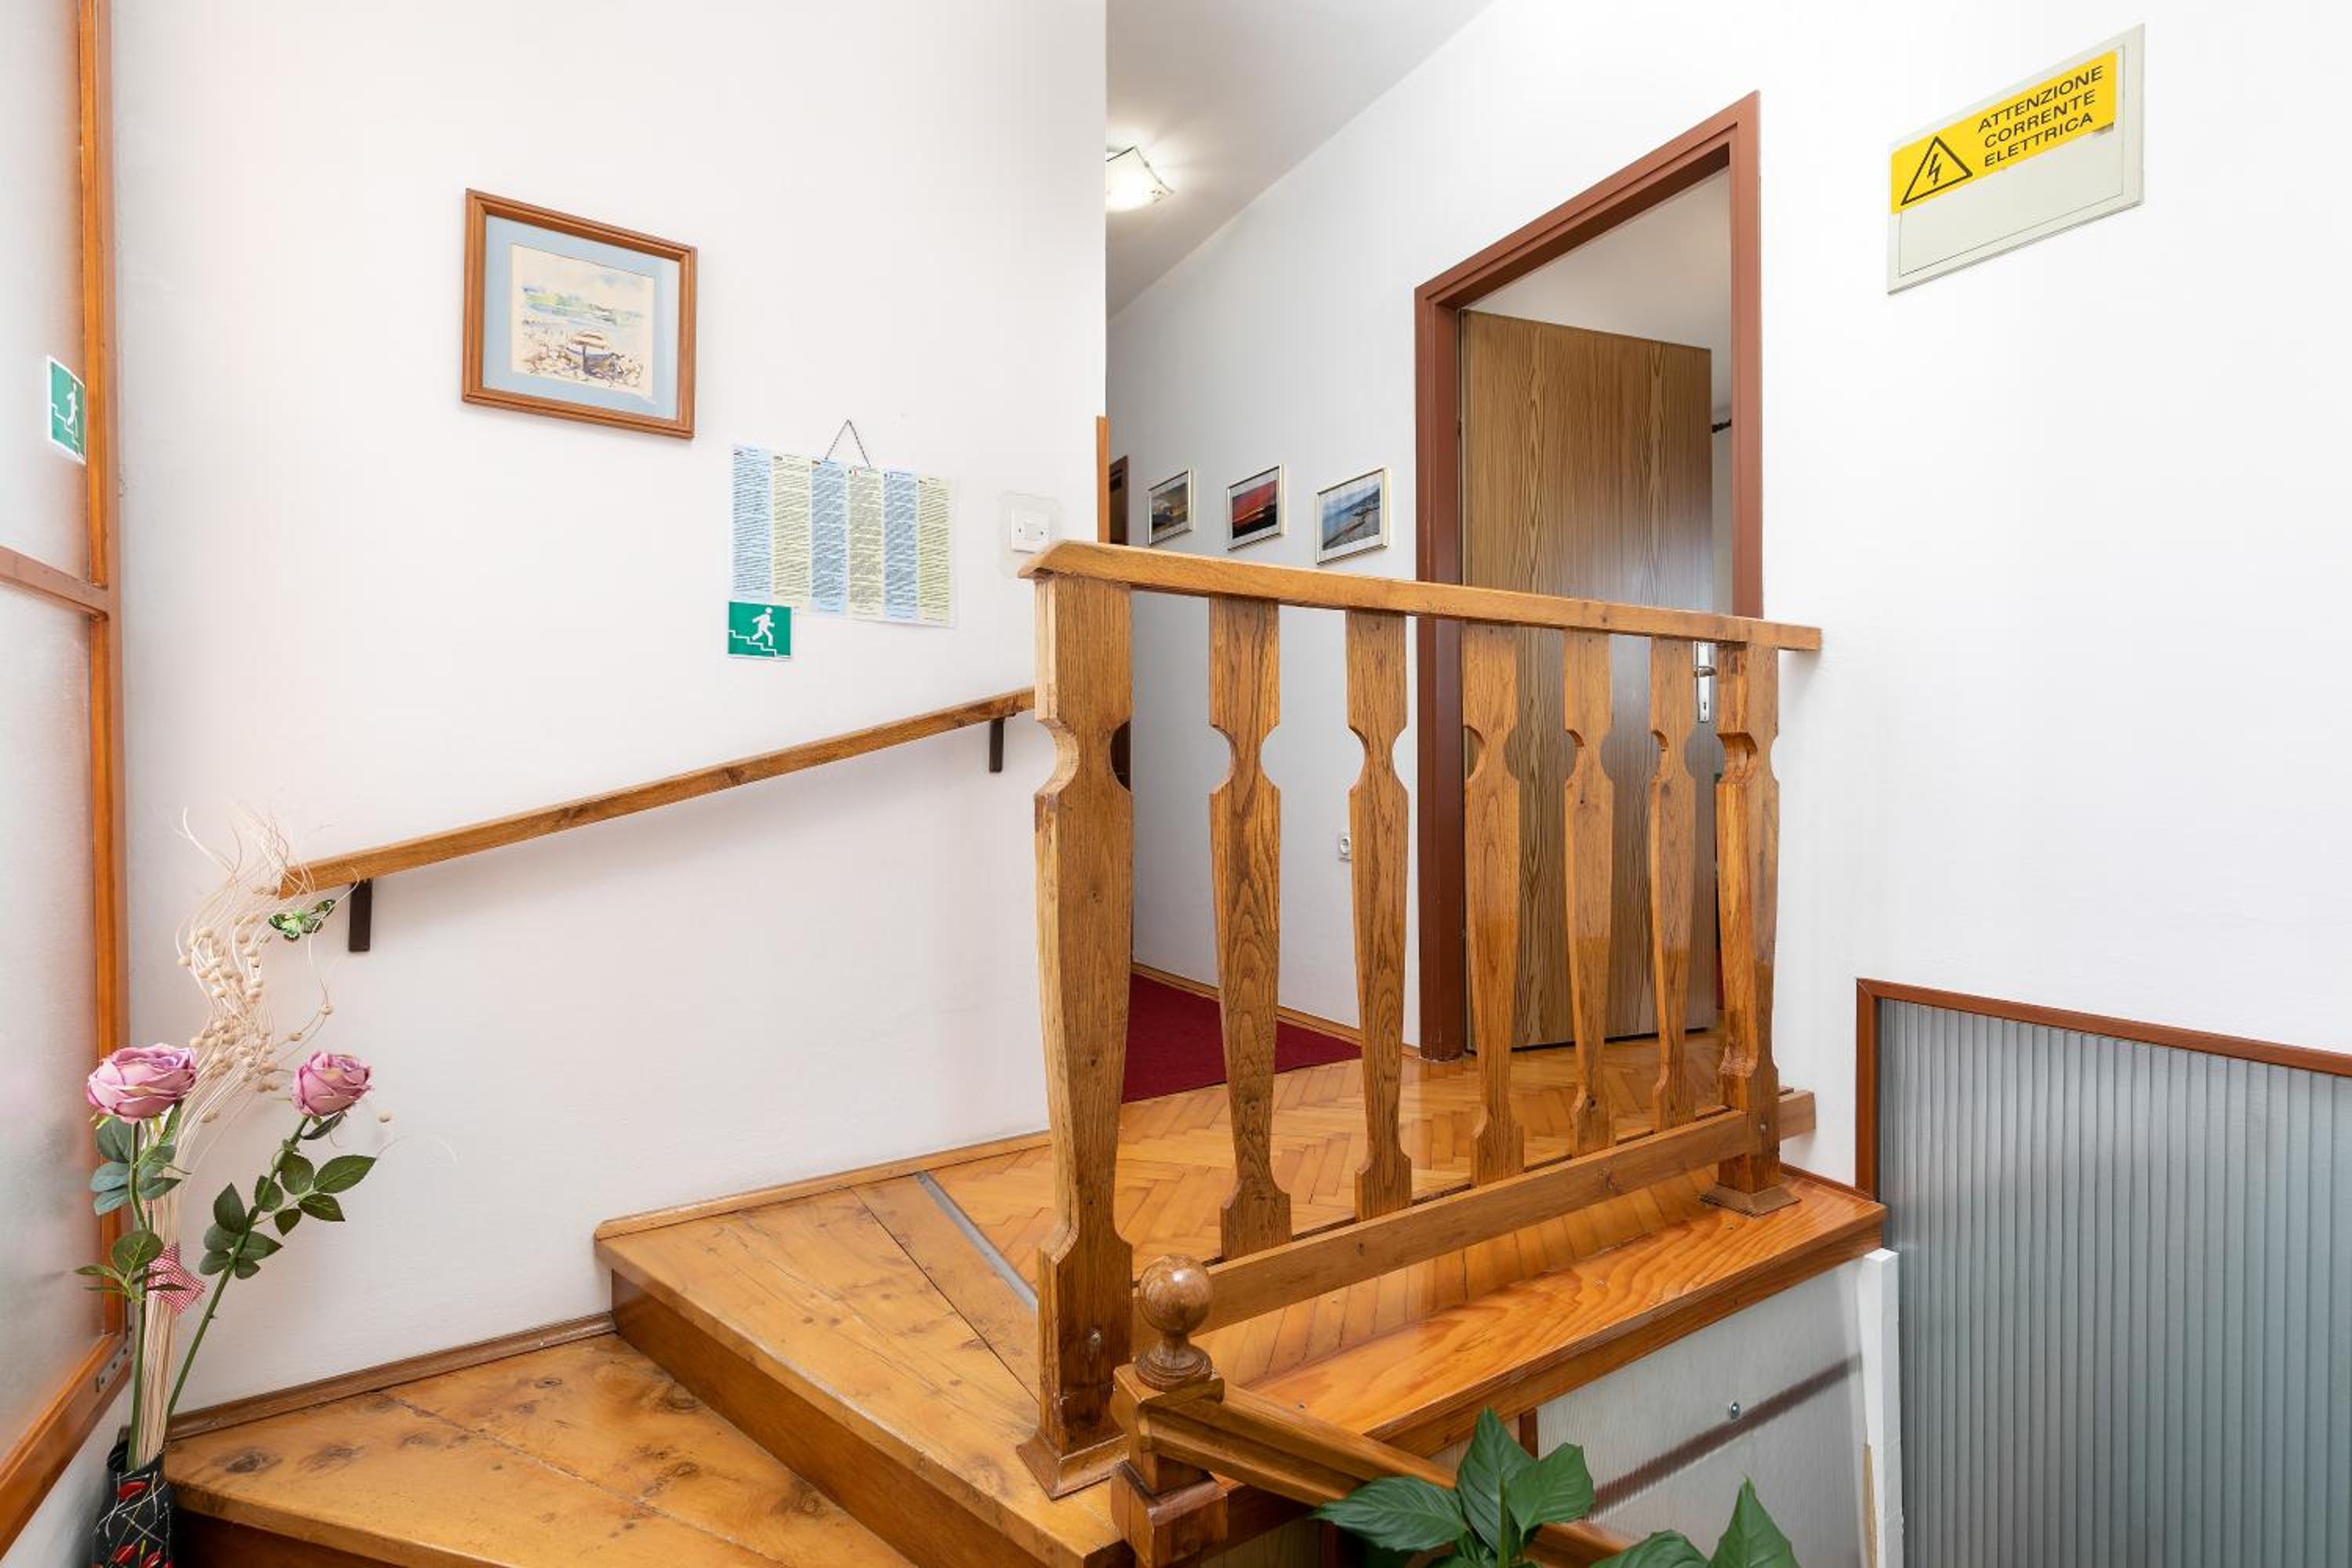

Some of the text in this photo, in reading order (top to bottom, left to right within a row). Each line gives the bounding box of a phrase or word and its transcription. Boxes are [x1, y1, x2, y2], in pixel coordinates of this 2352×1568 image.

[1978, 65, 2103, 132] ATTENZIONE
[1984, 89, 2096, 148] CORRENTE
[1984, 112, 2093, 167] ELETTRICA
